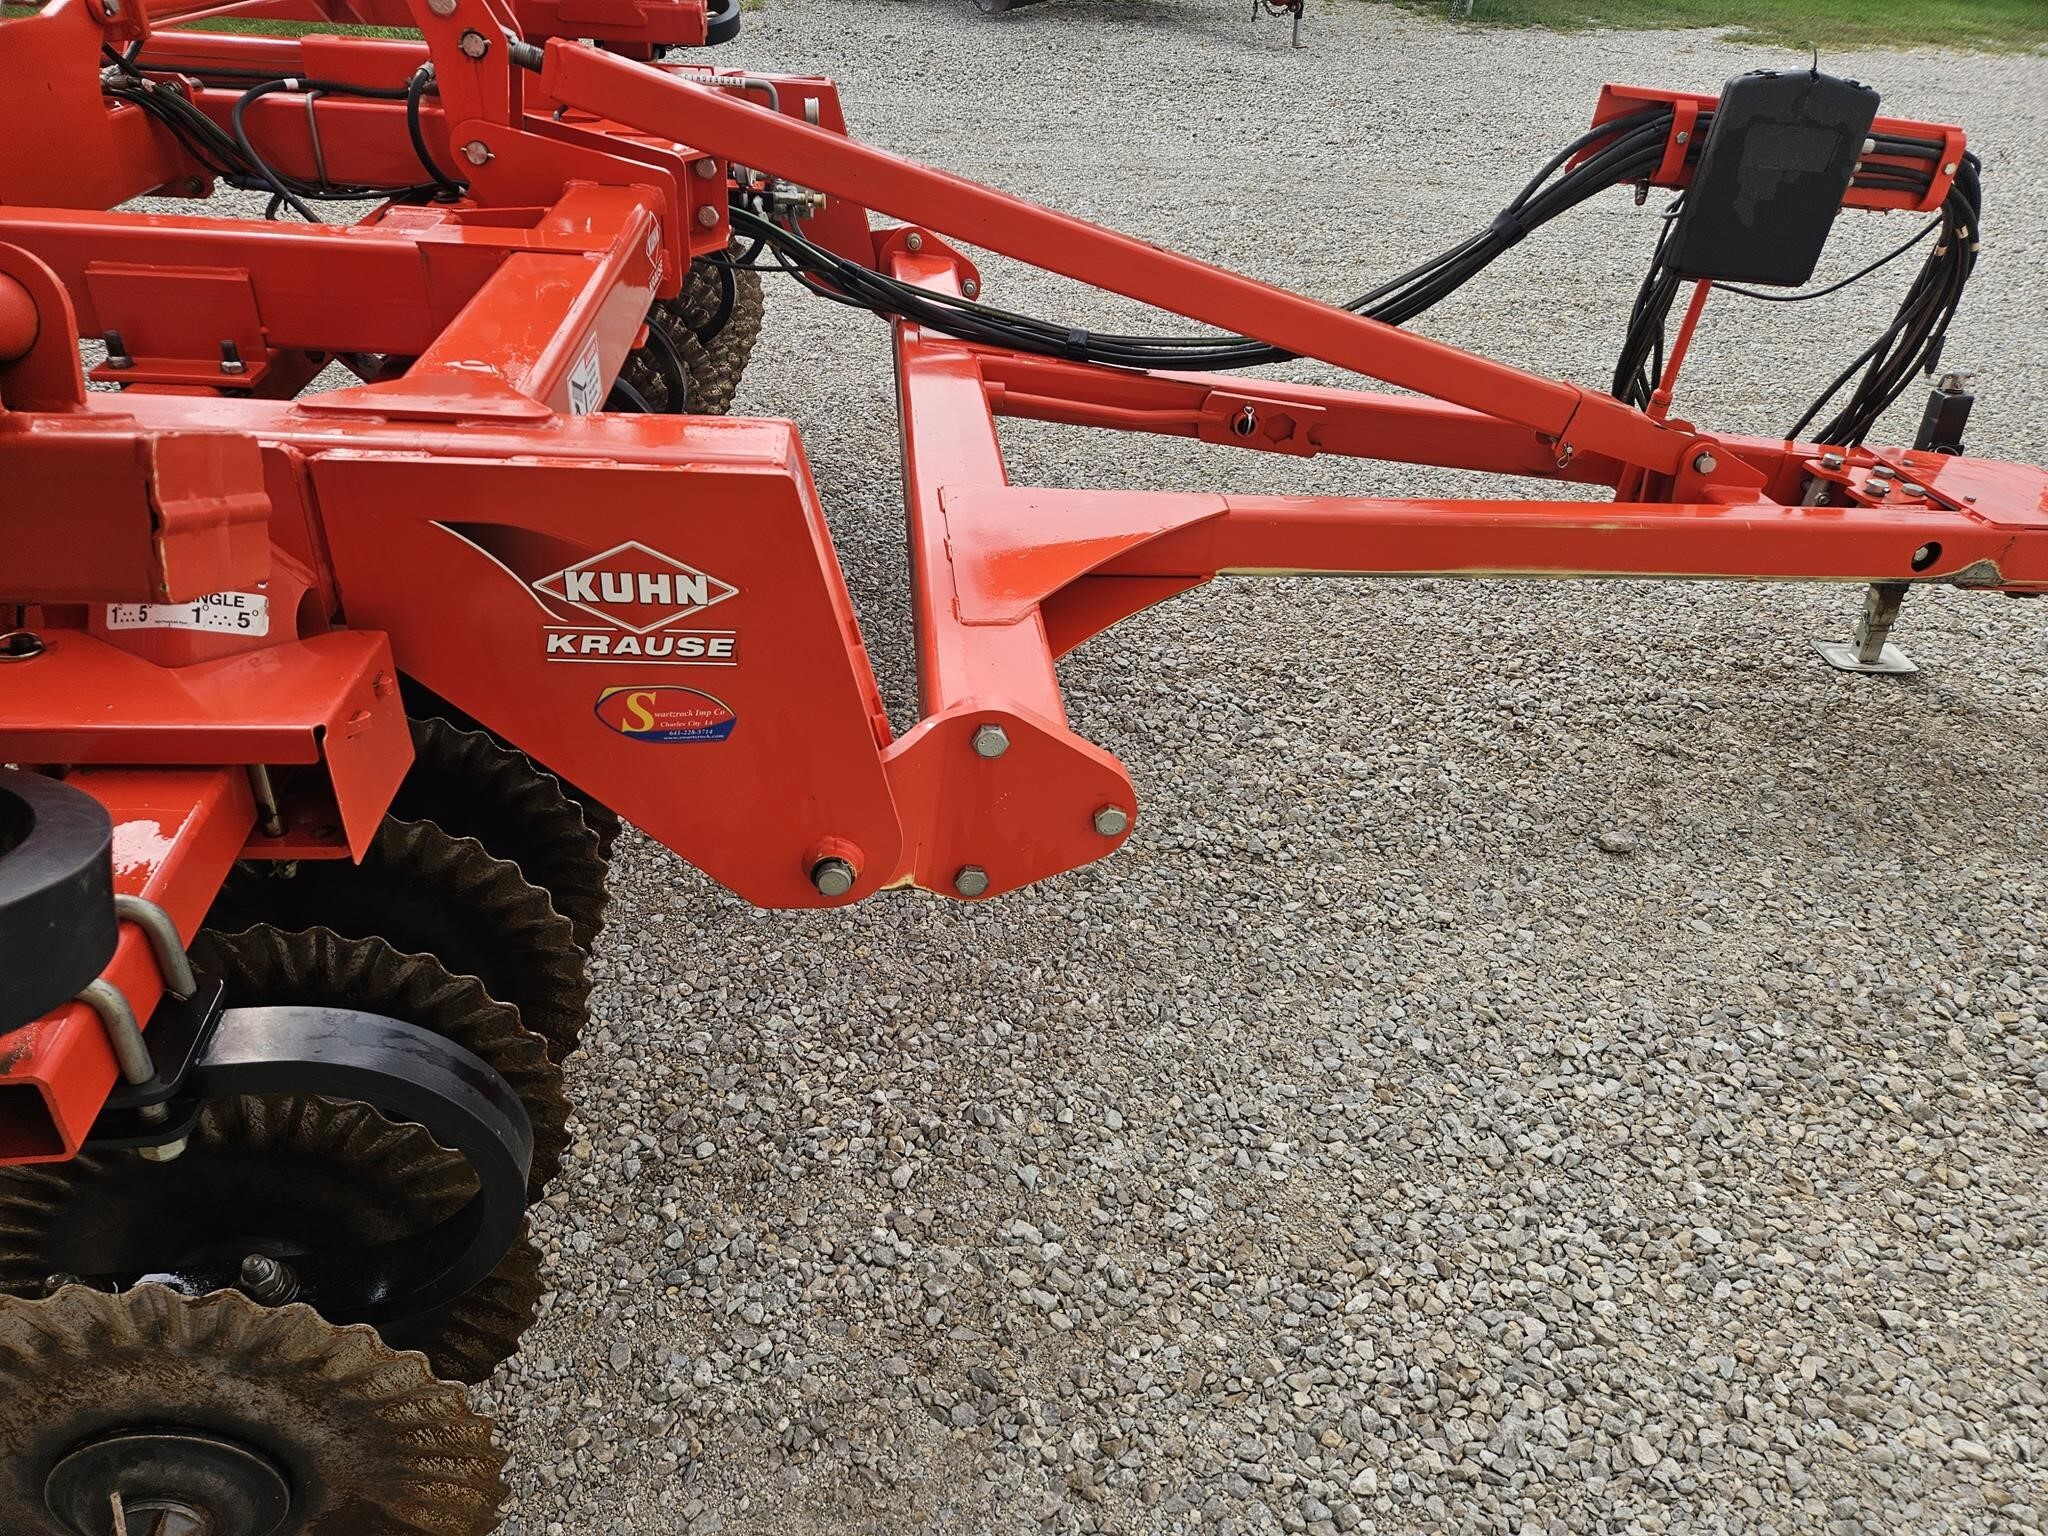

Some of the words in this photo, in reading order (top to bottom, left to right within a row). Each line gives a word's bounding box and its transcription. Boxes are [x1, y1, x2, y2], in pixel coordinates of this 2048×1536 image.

[564, 571, 708, 605] KUHN
[547, 634, 735, 657] KRAUSE
[713, 708, 726, 716] Co
